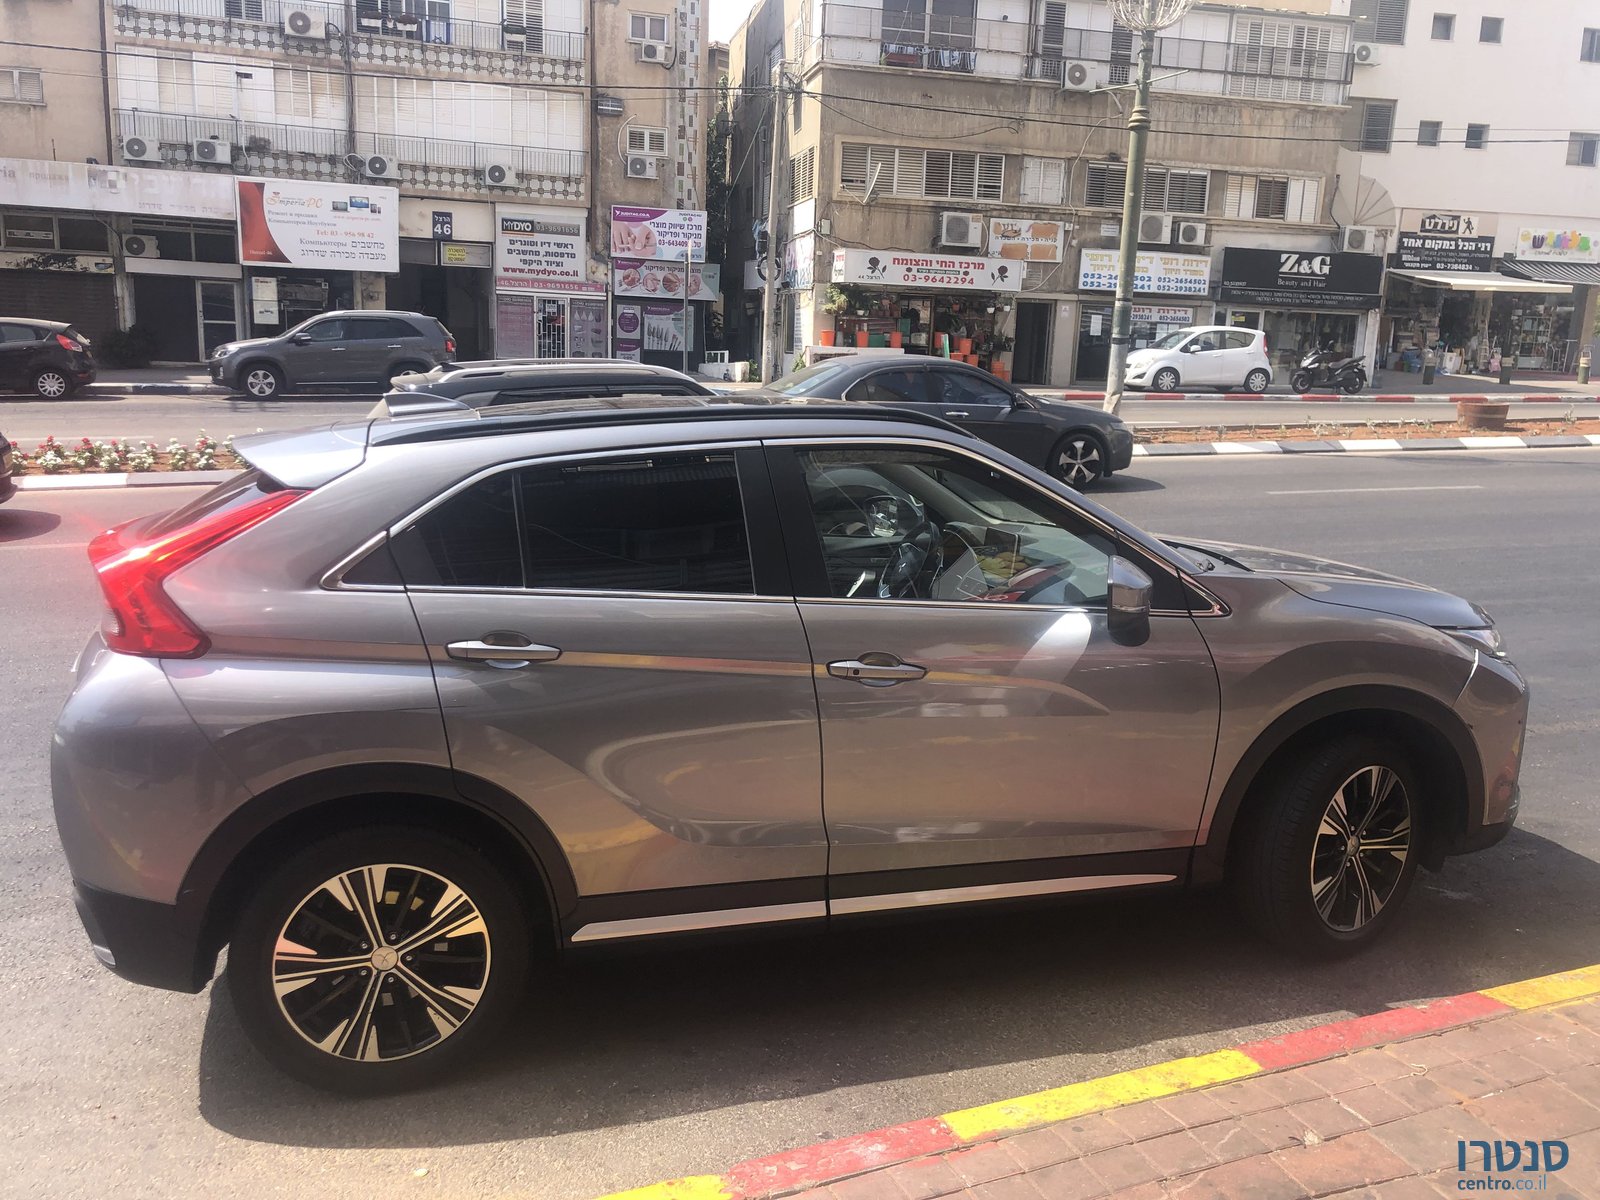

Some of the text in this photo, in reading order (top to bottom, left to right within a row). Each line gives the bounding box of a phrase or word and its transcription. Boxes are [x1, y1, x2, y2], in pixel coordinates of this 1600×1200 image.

[434, 224, 452, 234] 46
[503, 220, 579, 234] MYDYO 03-9691656
[668, 222, 685, 231] שיווק
[656, 230, 702, 240] מניקור ופדיקור
[351, 240, 385, 250] מחשבים
[509, 238, 538, 248] וטונרים
[554, 241, 574, 250] ראשי
[658, 240, 688, 248] 03-643409
[1402, 238, 1491, 251] רני הכל במקום אחד
[300, 249, 386, 260] מעבדה מכירה שדרוג
[507, 248, 540, 257] מחשבים
[520, 258, 542, 267] היקפי
[892, 256, 985, 270] מרכז החי והצומח
[1182, 258, 1208, 267] דירות
[1279, 253, 1332, 276] Z&G
[502, 266, 578, 278] www.mydyo.co.il
[666, 264, 684, 273] מניקור
[903, 274, 975, 286] 03-9642294
[1082, 272, 1152, 282] 052-26502
[1158, 276, 1206, 286] 052-2654502
[1082, 280, 1152, 290] 052-29241
[1277, 278, 1328, 288] Beauty and Hair
[1156, 284, 1206, 294] 052-2938241
